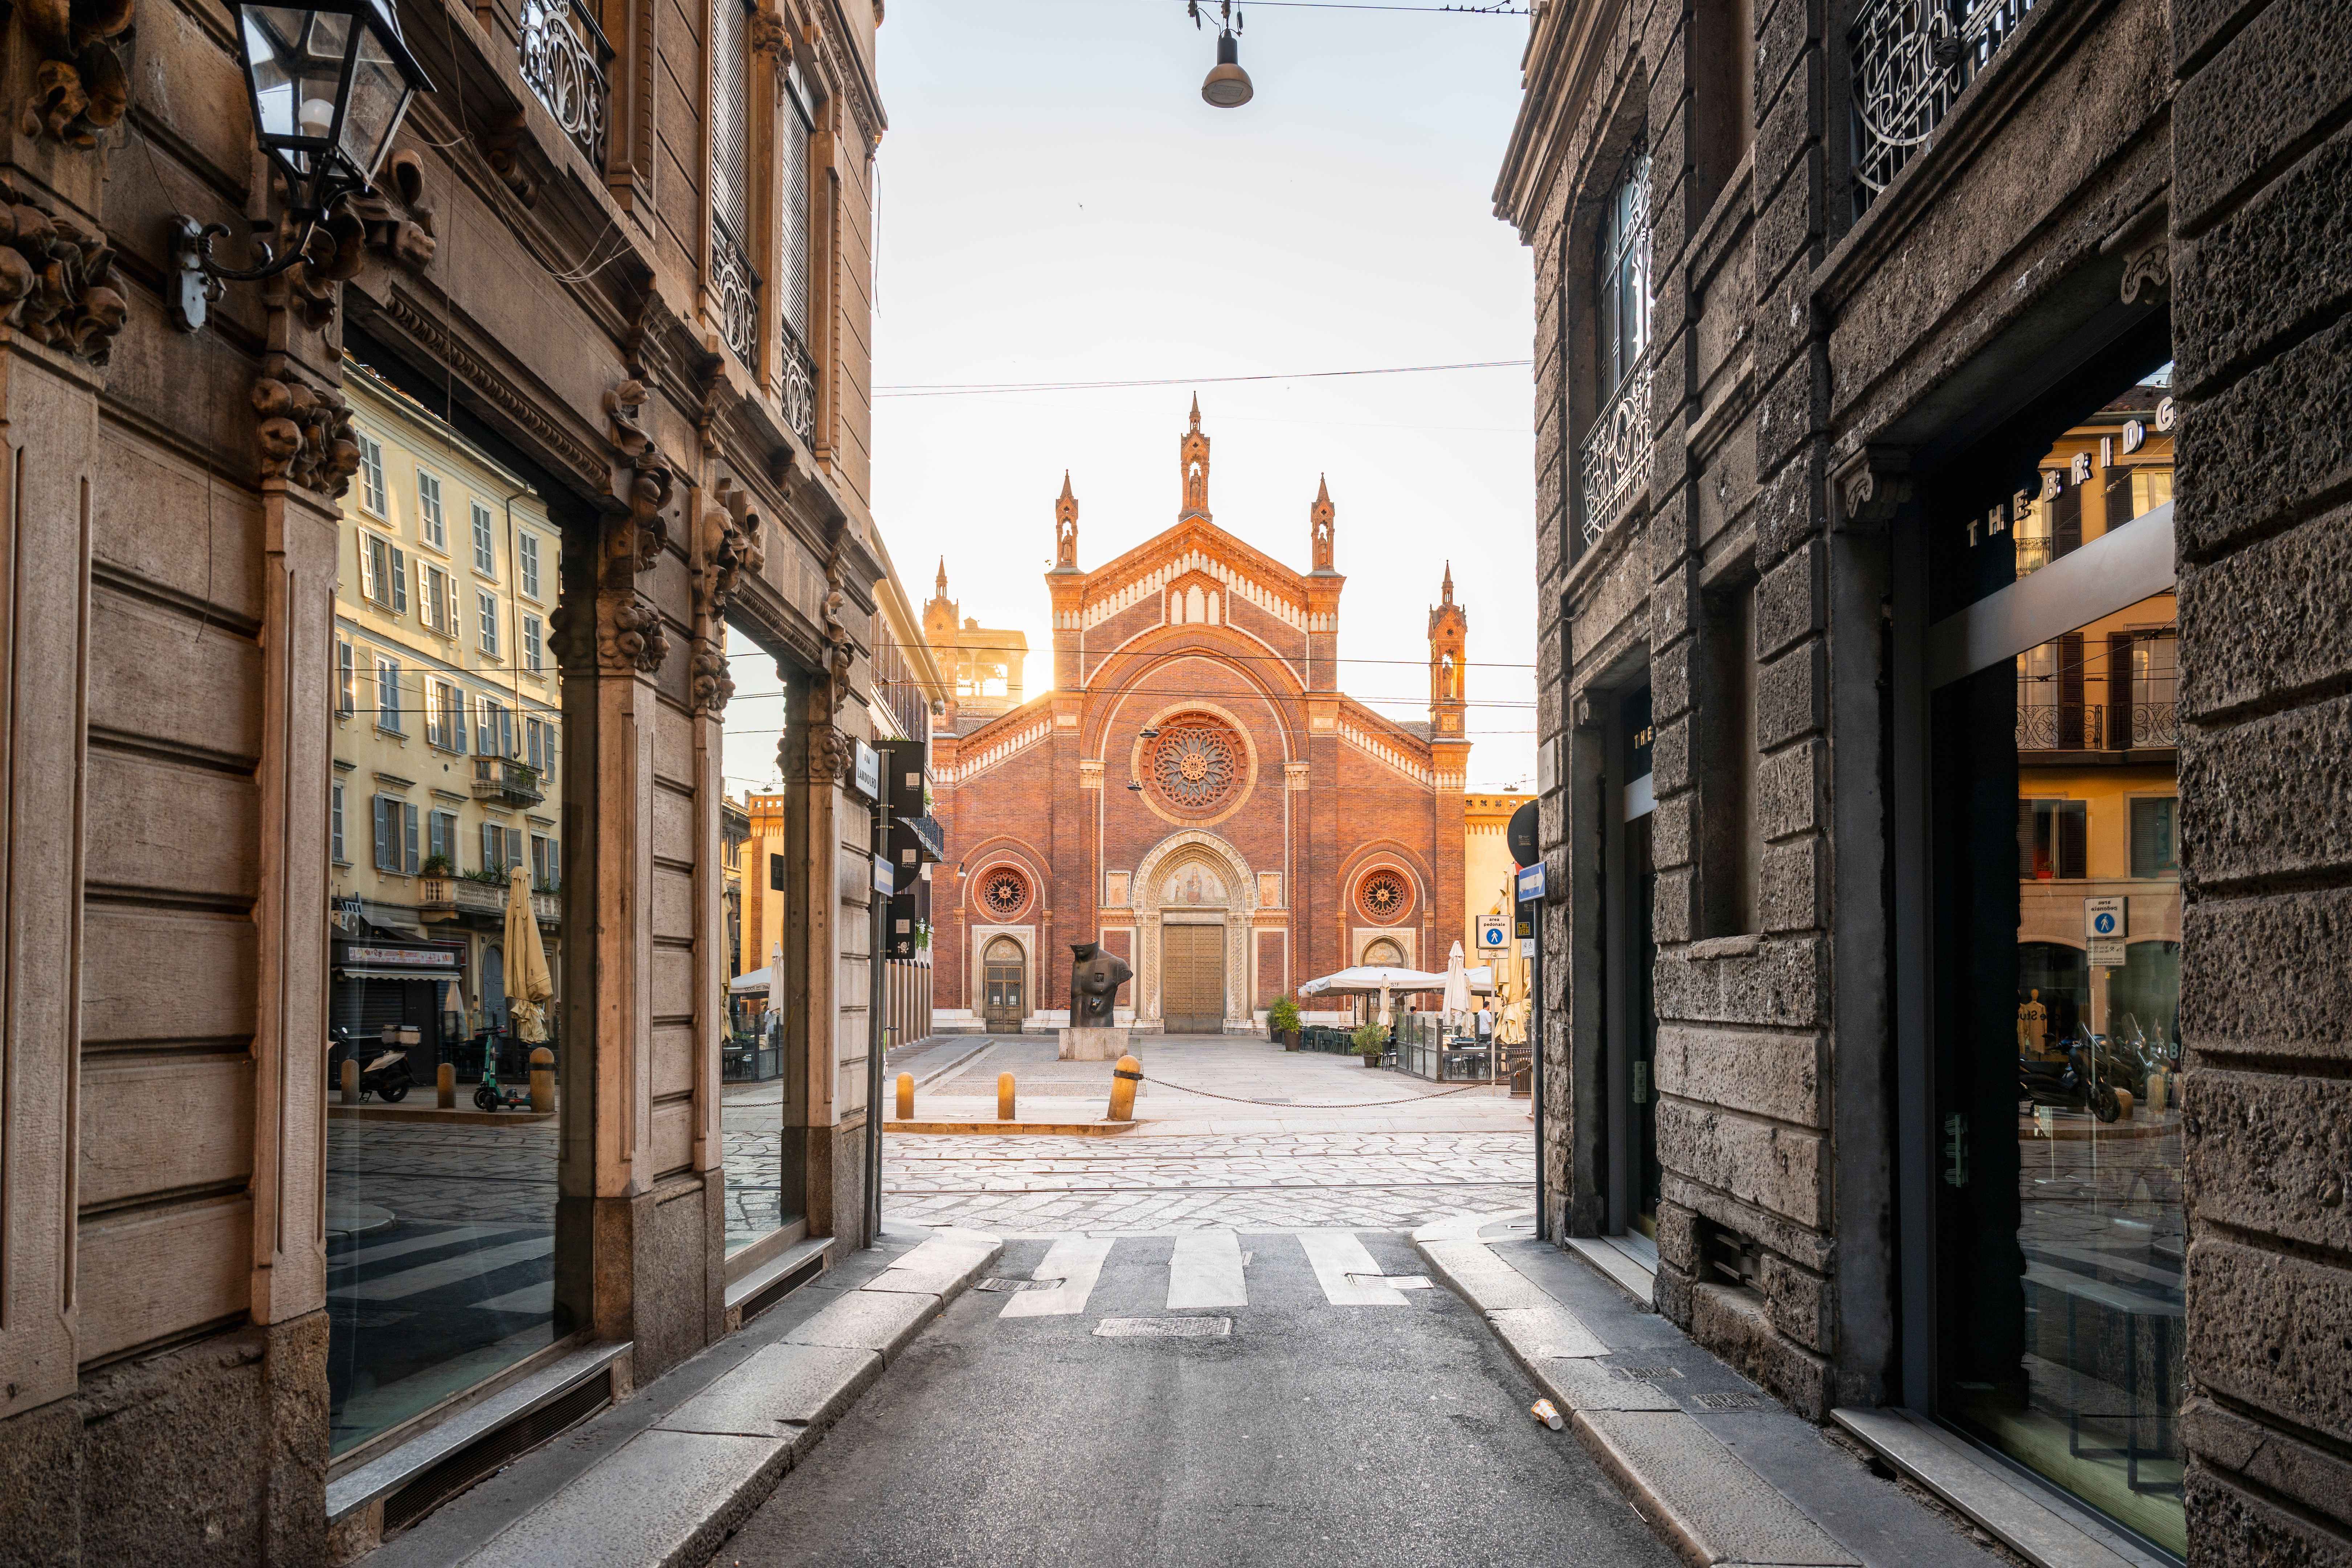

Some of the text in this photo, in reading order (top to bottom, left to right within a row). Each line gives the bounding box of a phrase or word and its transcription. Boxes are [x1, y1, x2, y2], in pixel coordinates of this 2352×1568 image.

[1967, 489, 2031, 548] THE
[1634, 726, 1653, 749] THE
[858, 767, 876, 789] LANDOLFO
